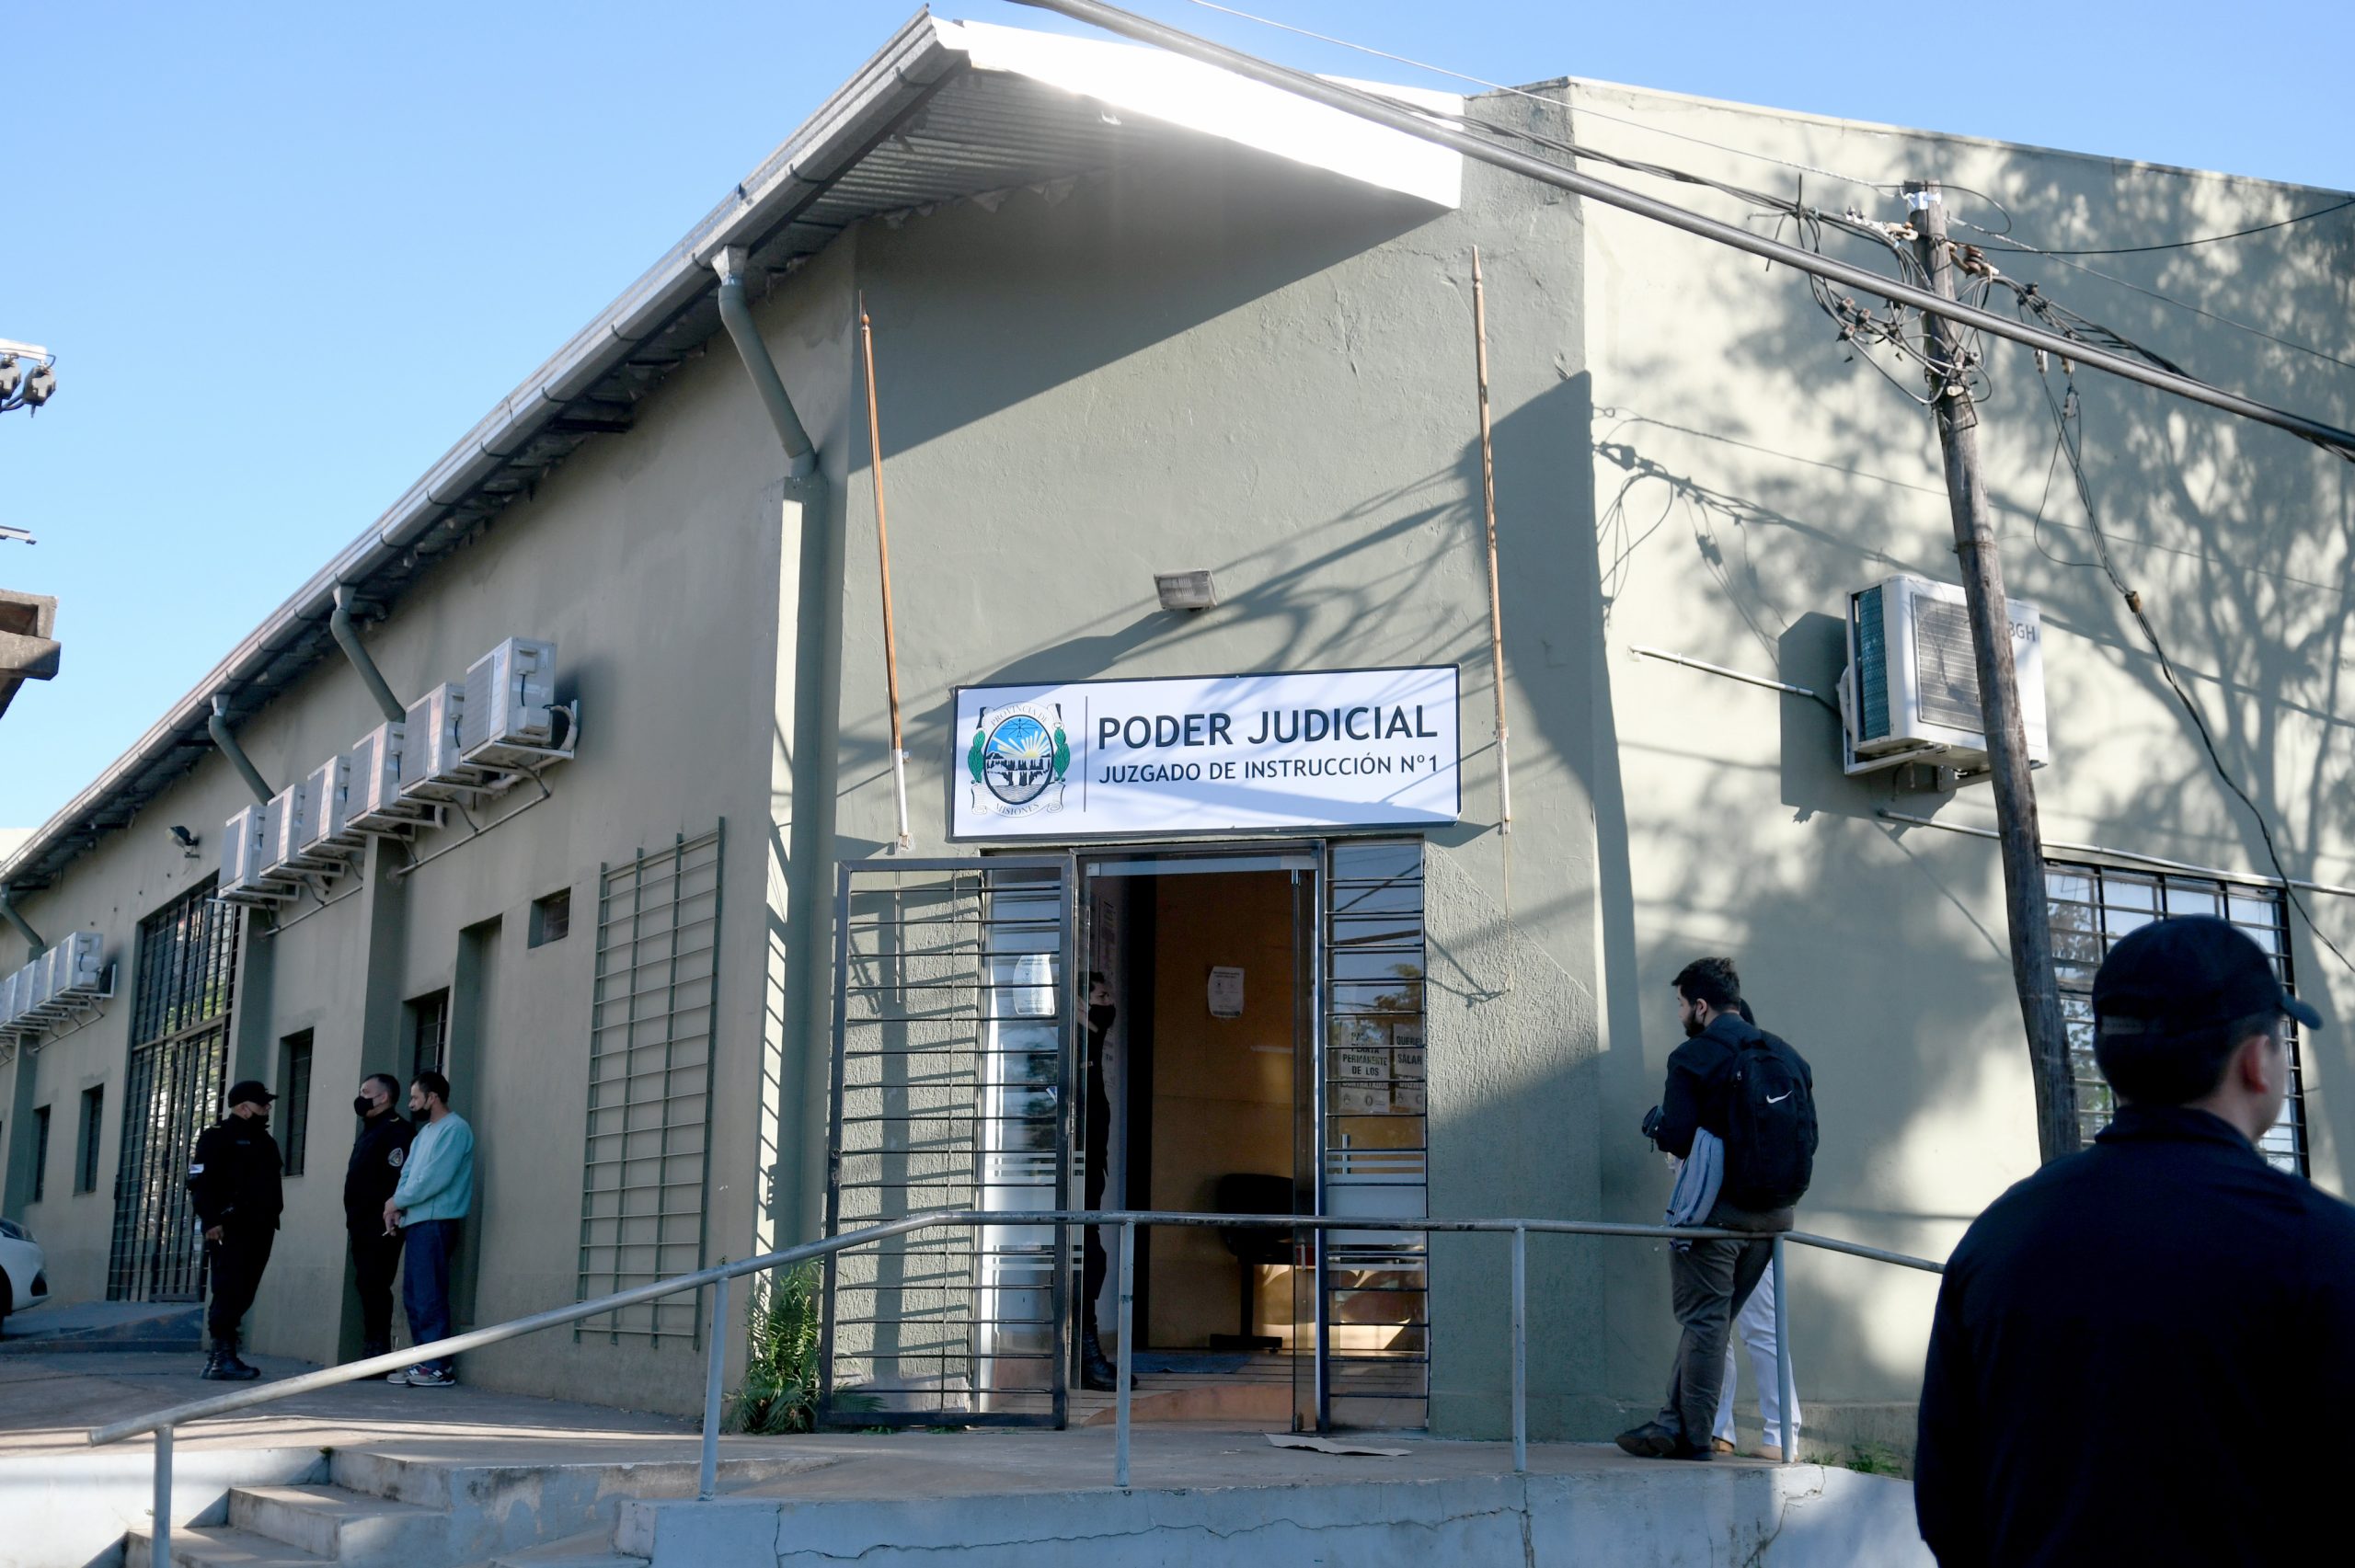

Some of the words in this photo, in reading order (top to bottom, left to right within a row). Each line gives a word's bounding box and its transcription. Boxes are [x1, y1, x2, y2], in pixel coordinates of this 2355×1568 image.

[2008, 621, 2036, 642] BGH
[991, 704, 1036, 727] PROVINCIA
[1037, 711, 1049, 724] DE
[1098, 712, 1234, 750] PODER
[1247, 704, 1438, 744] JUDICIAL
[1099, 762, 1200, 784] JUZGADO
[1210, 761, 1235, 780] DE
[1245, 751, 1391, 779] INSTRUCCIÓN
[994, 802, 1040, 816] MISIONES
[1342, 1053, 1387, 1066] PERMANENTE
[1351, 1066, 1361, 1075] DE
[1366, 1067, 1380, 1076] LOS
